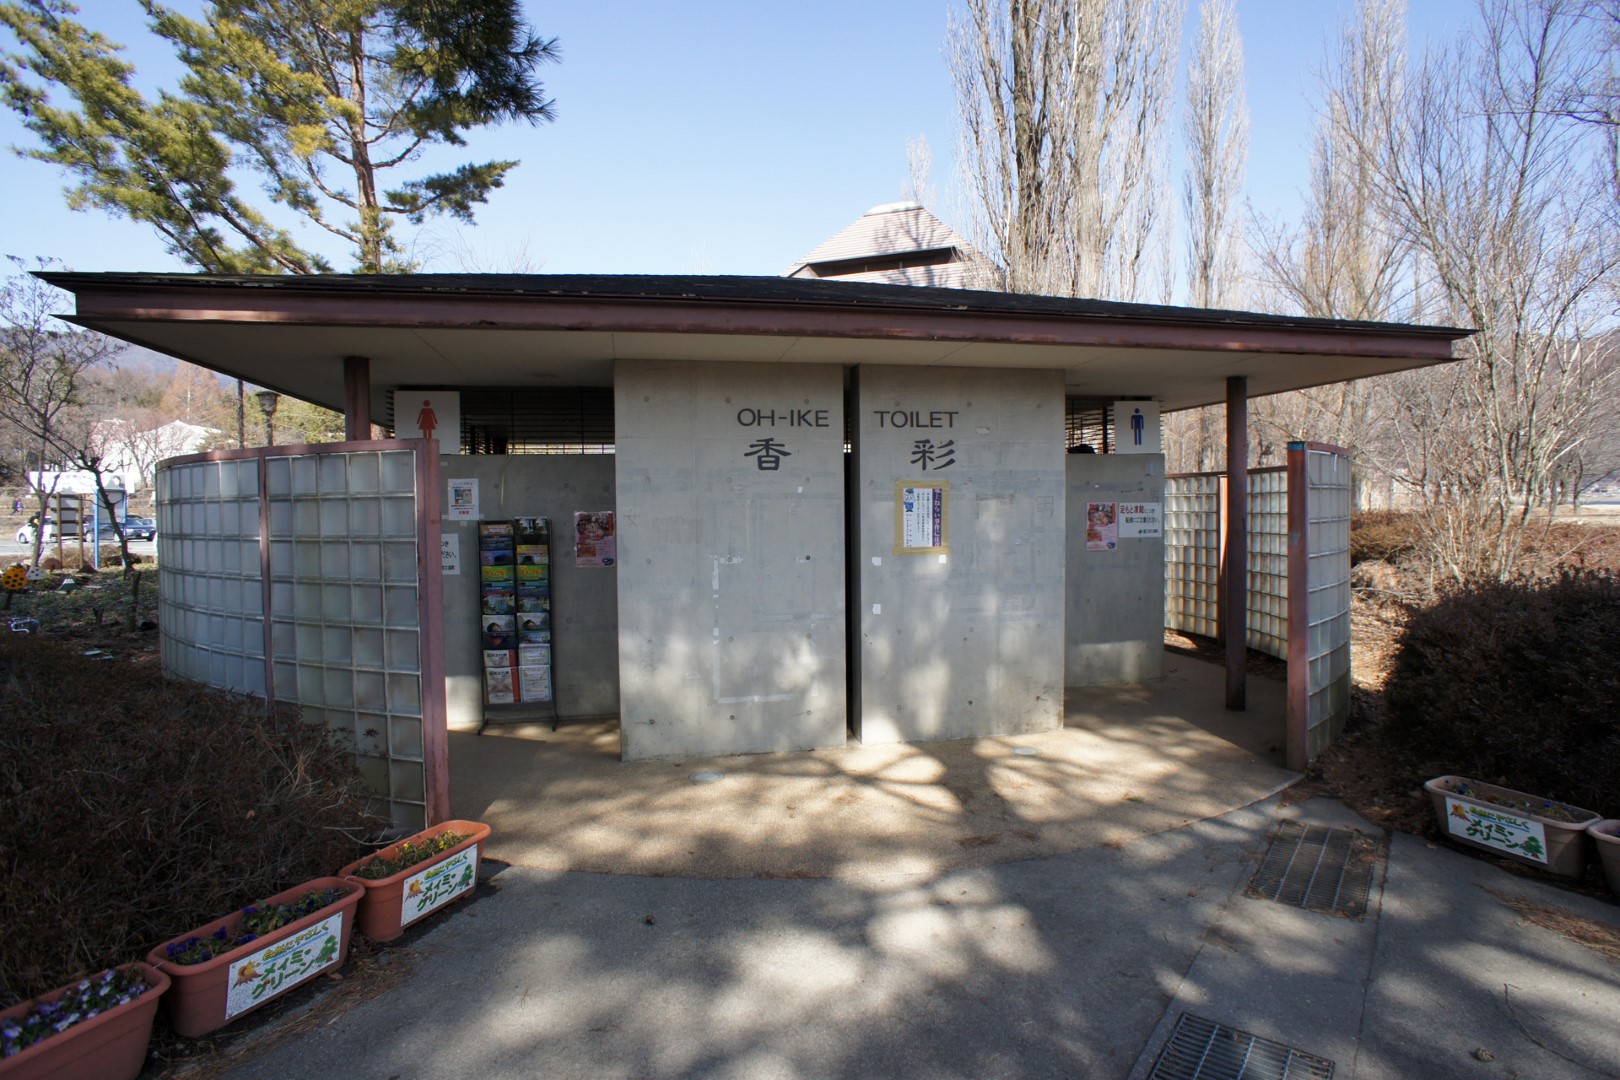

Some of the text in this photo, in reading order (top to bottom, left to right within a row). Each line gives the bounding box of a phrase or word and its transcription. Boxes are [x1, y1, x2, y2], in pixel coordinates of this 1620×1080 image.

[737, 408, 959, 428] OH-IKE TOILET
[744, 437, 792, 471] 香
[910, 438, 956, 471] 彩
